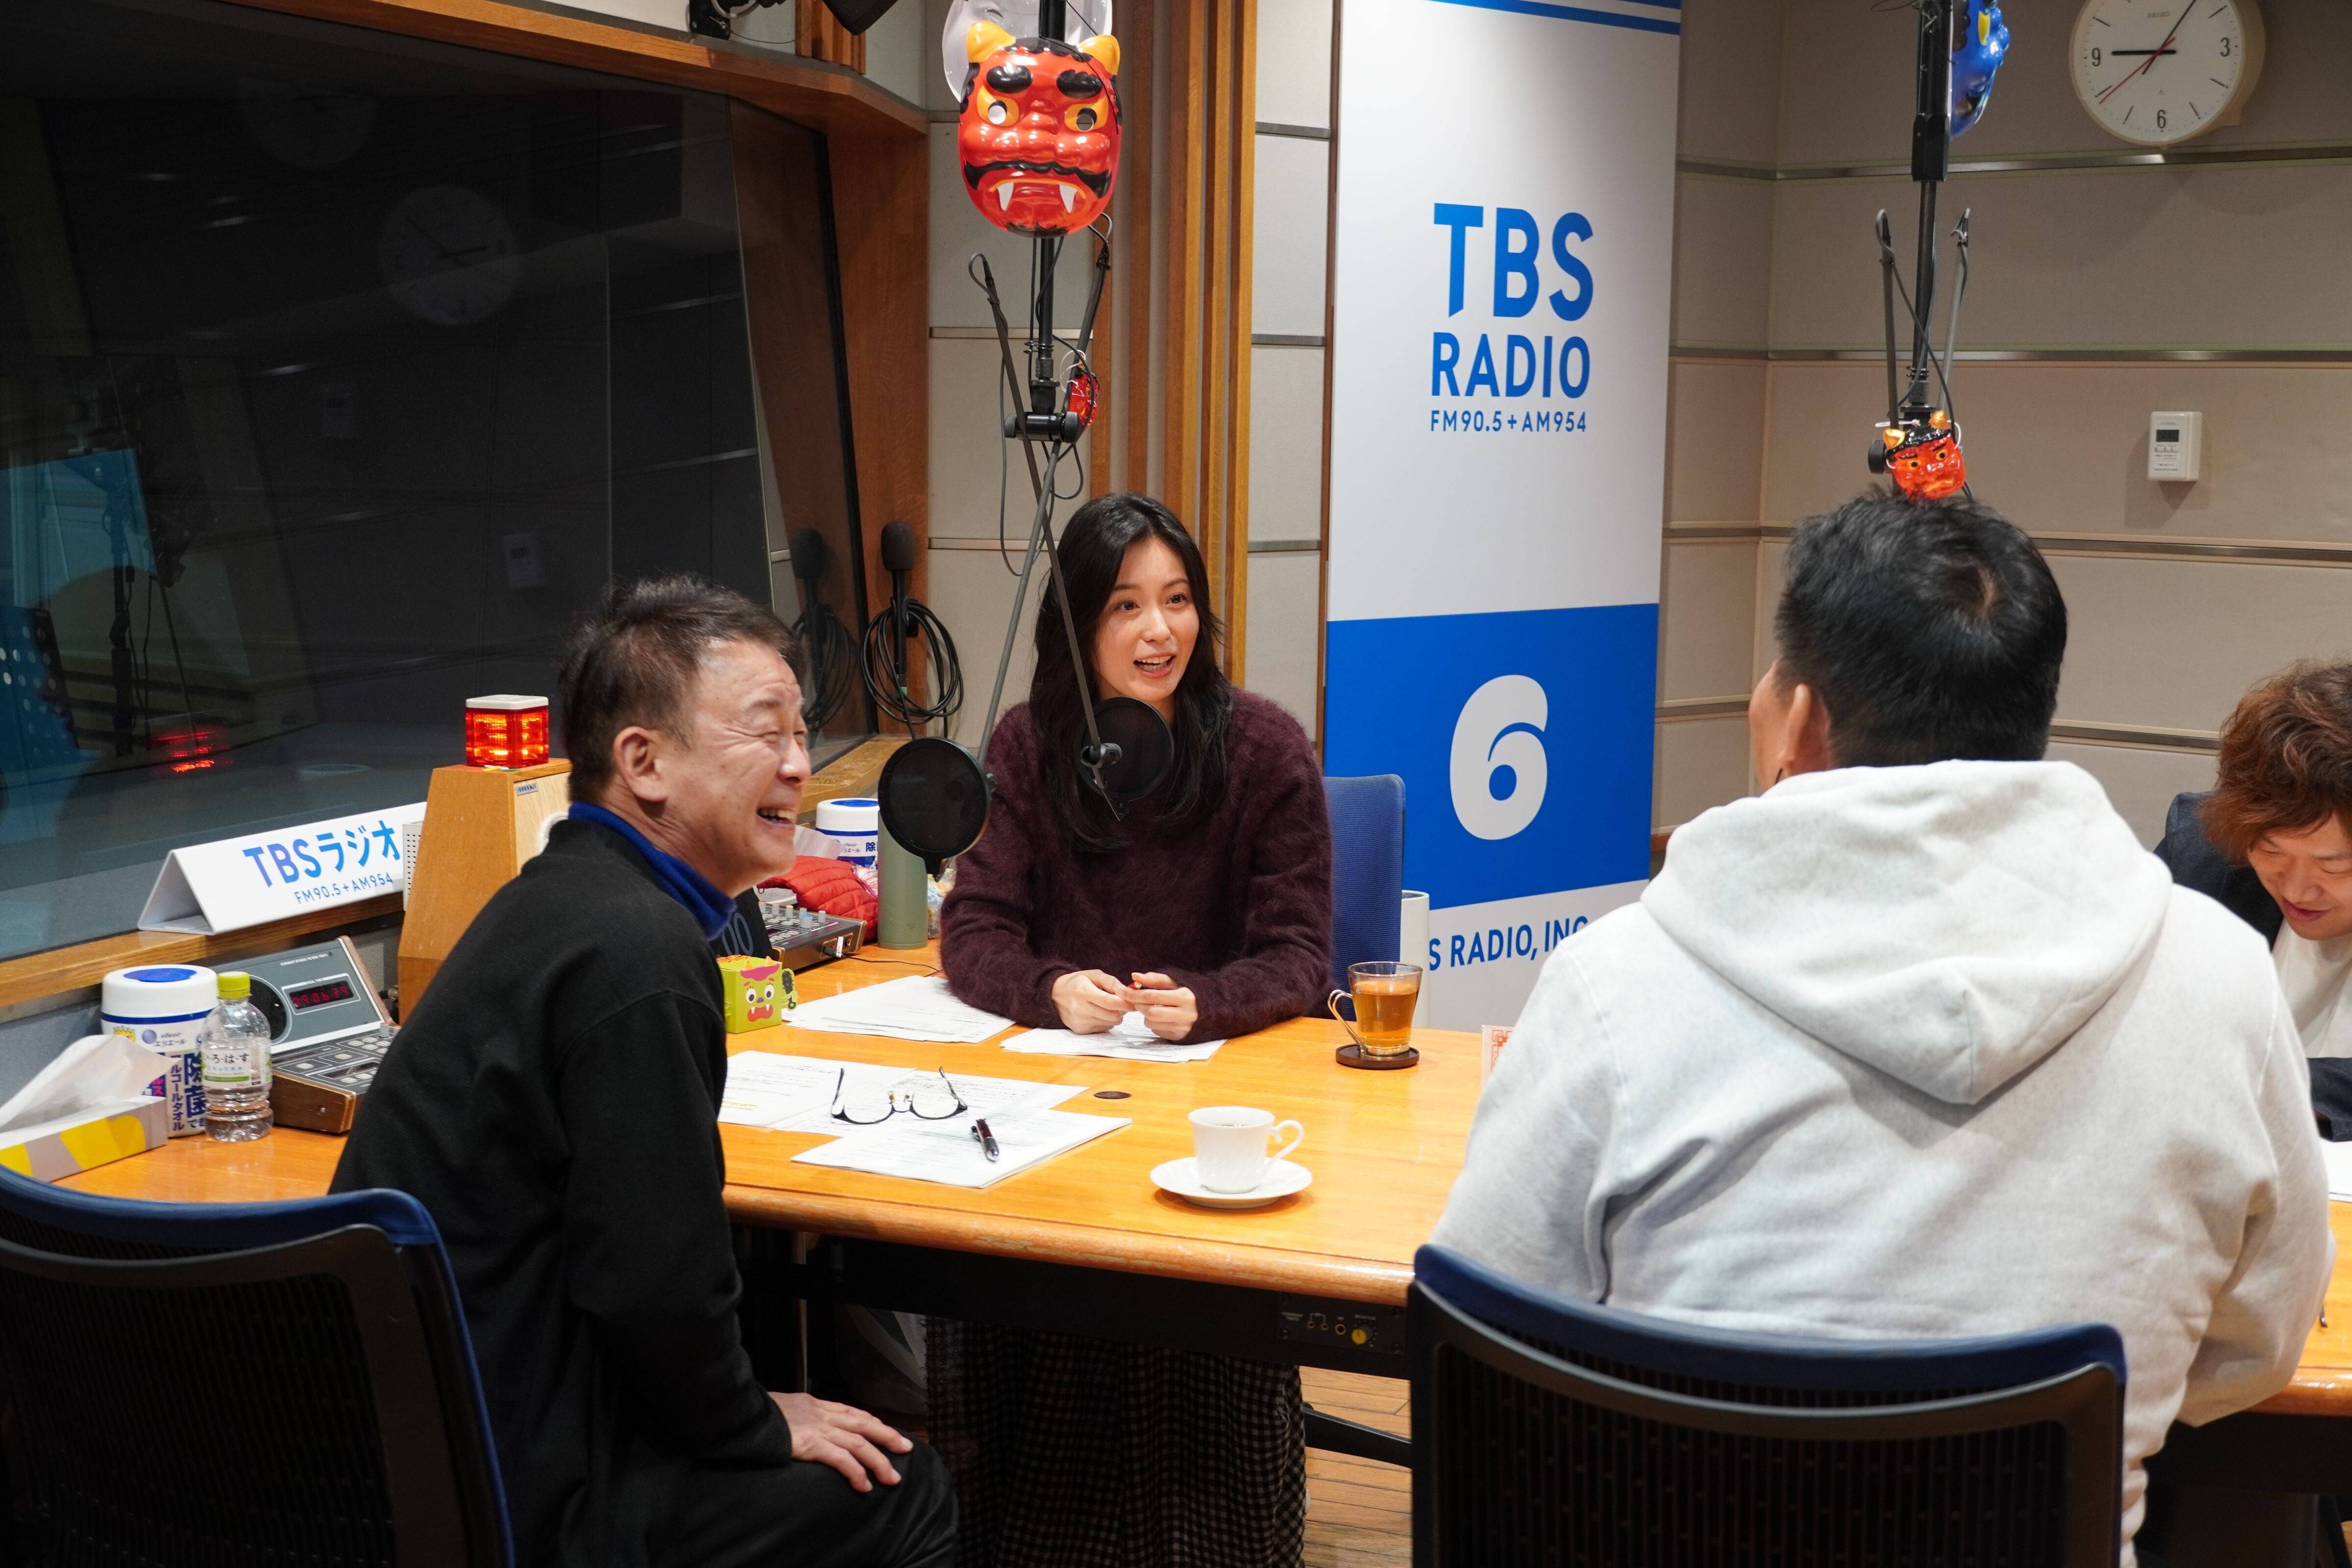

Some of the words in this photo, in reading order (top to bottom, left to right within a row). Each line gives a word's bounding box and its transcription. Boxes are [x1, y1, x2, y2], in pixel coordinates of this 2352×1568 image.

[2091, 48, 2101, 67] 9
[2220, 37, 2230, 57] 3
[2156, 109, 2166, 129] 6
[1433, 202, 1593, 321] TBS
[1431, 331, 1590, 398] RADIO
[1449, 674, 1548, 840] 6
[242, 820, 400, 887] TBSラジオ
[866, 841, 878, 852] 除
[1450, 924, 1538, 967] RADIO,
[154, 1038, 187, 1047] エリエール
[170, 1054, 185, 1131] ルコールタオル
